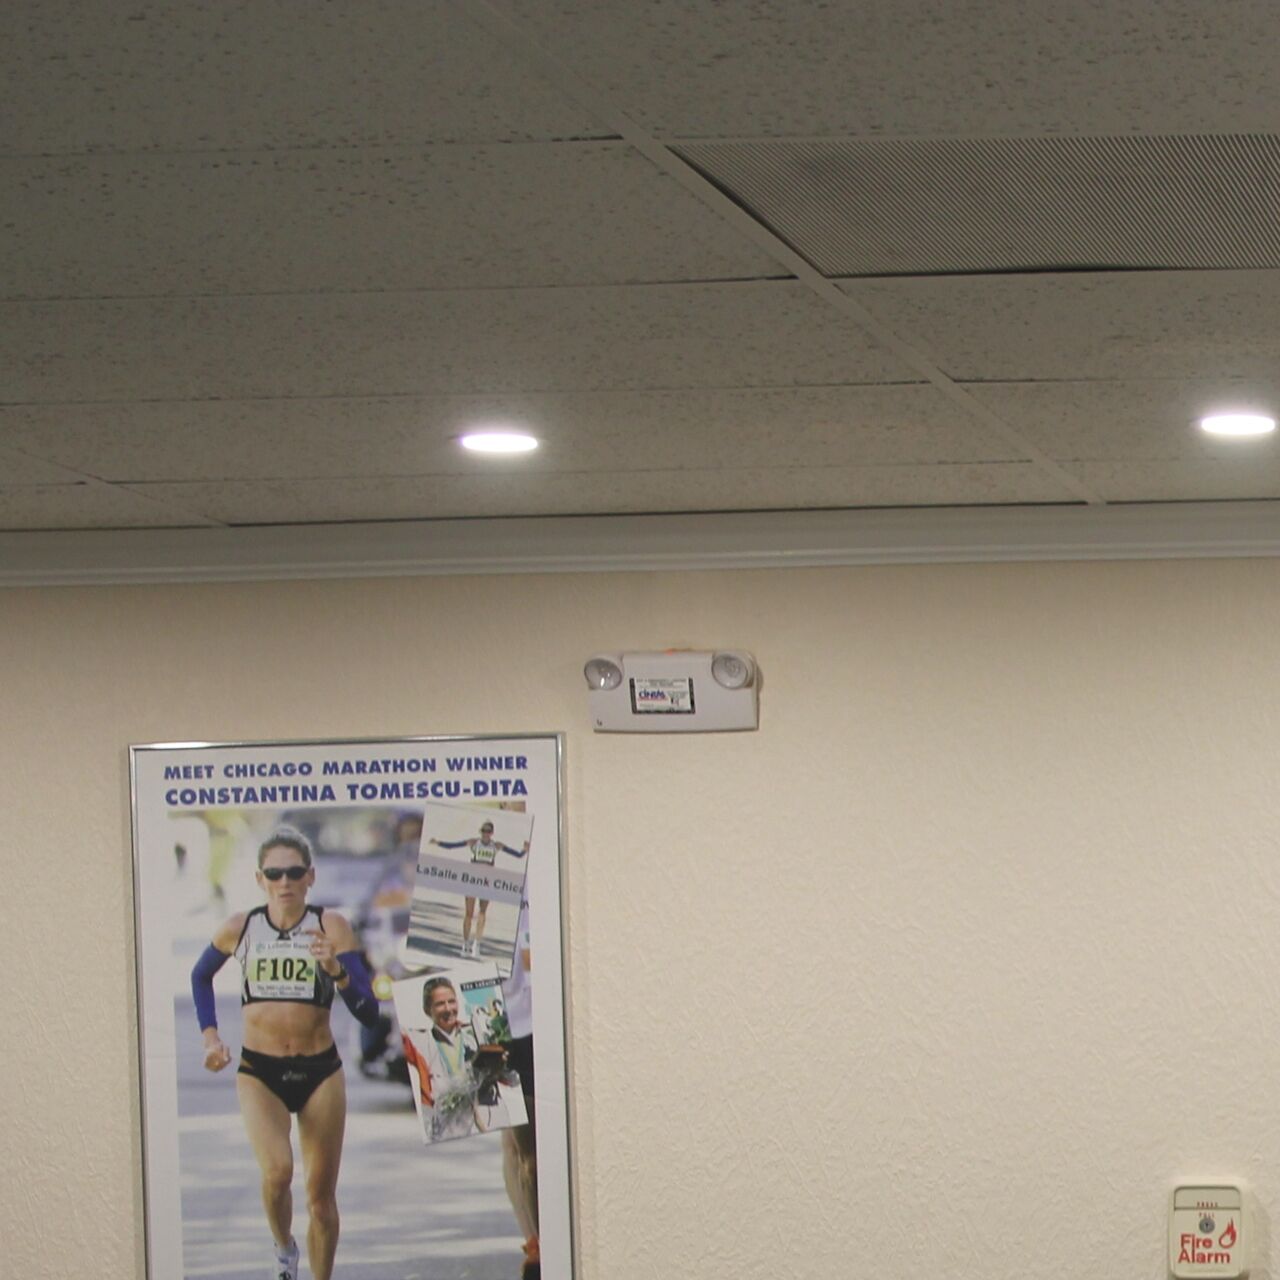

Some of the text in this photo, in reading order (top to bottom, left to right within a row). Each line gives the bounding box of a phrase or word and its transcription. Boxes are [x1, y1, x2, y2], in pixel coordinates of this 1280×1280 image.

[164, 756, 528, 780] MEET CHICAGO MARATHON WINNER
[165, 779, 528, 806] CONSTANTINA TOMESCU-DITA
[416, 864, 458, 881] LaSalle
[461, 872, 491, 888] Bank
[257, 957, 308, 982] F102
[1180, 1232, 1213, 1249] Fire
[1178, 1248, 1231, 1263] Alarm
